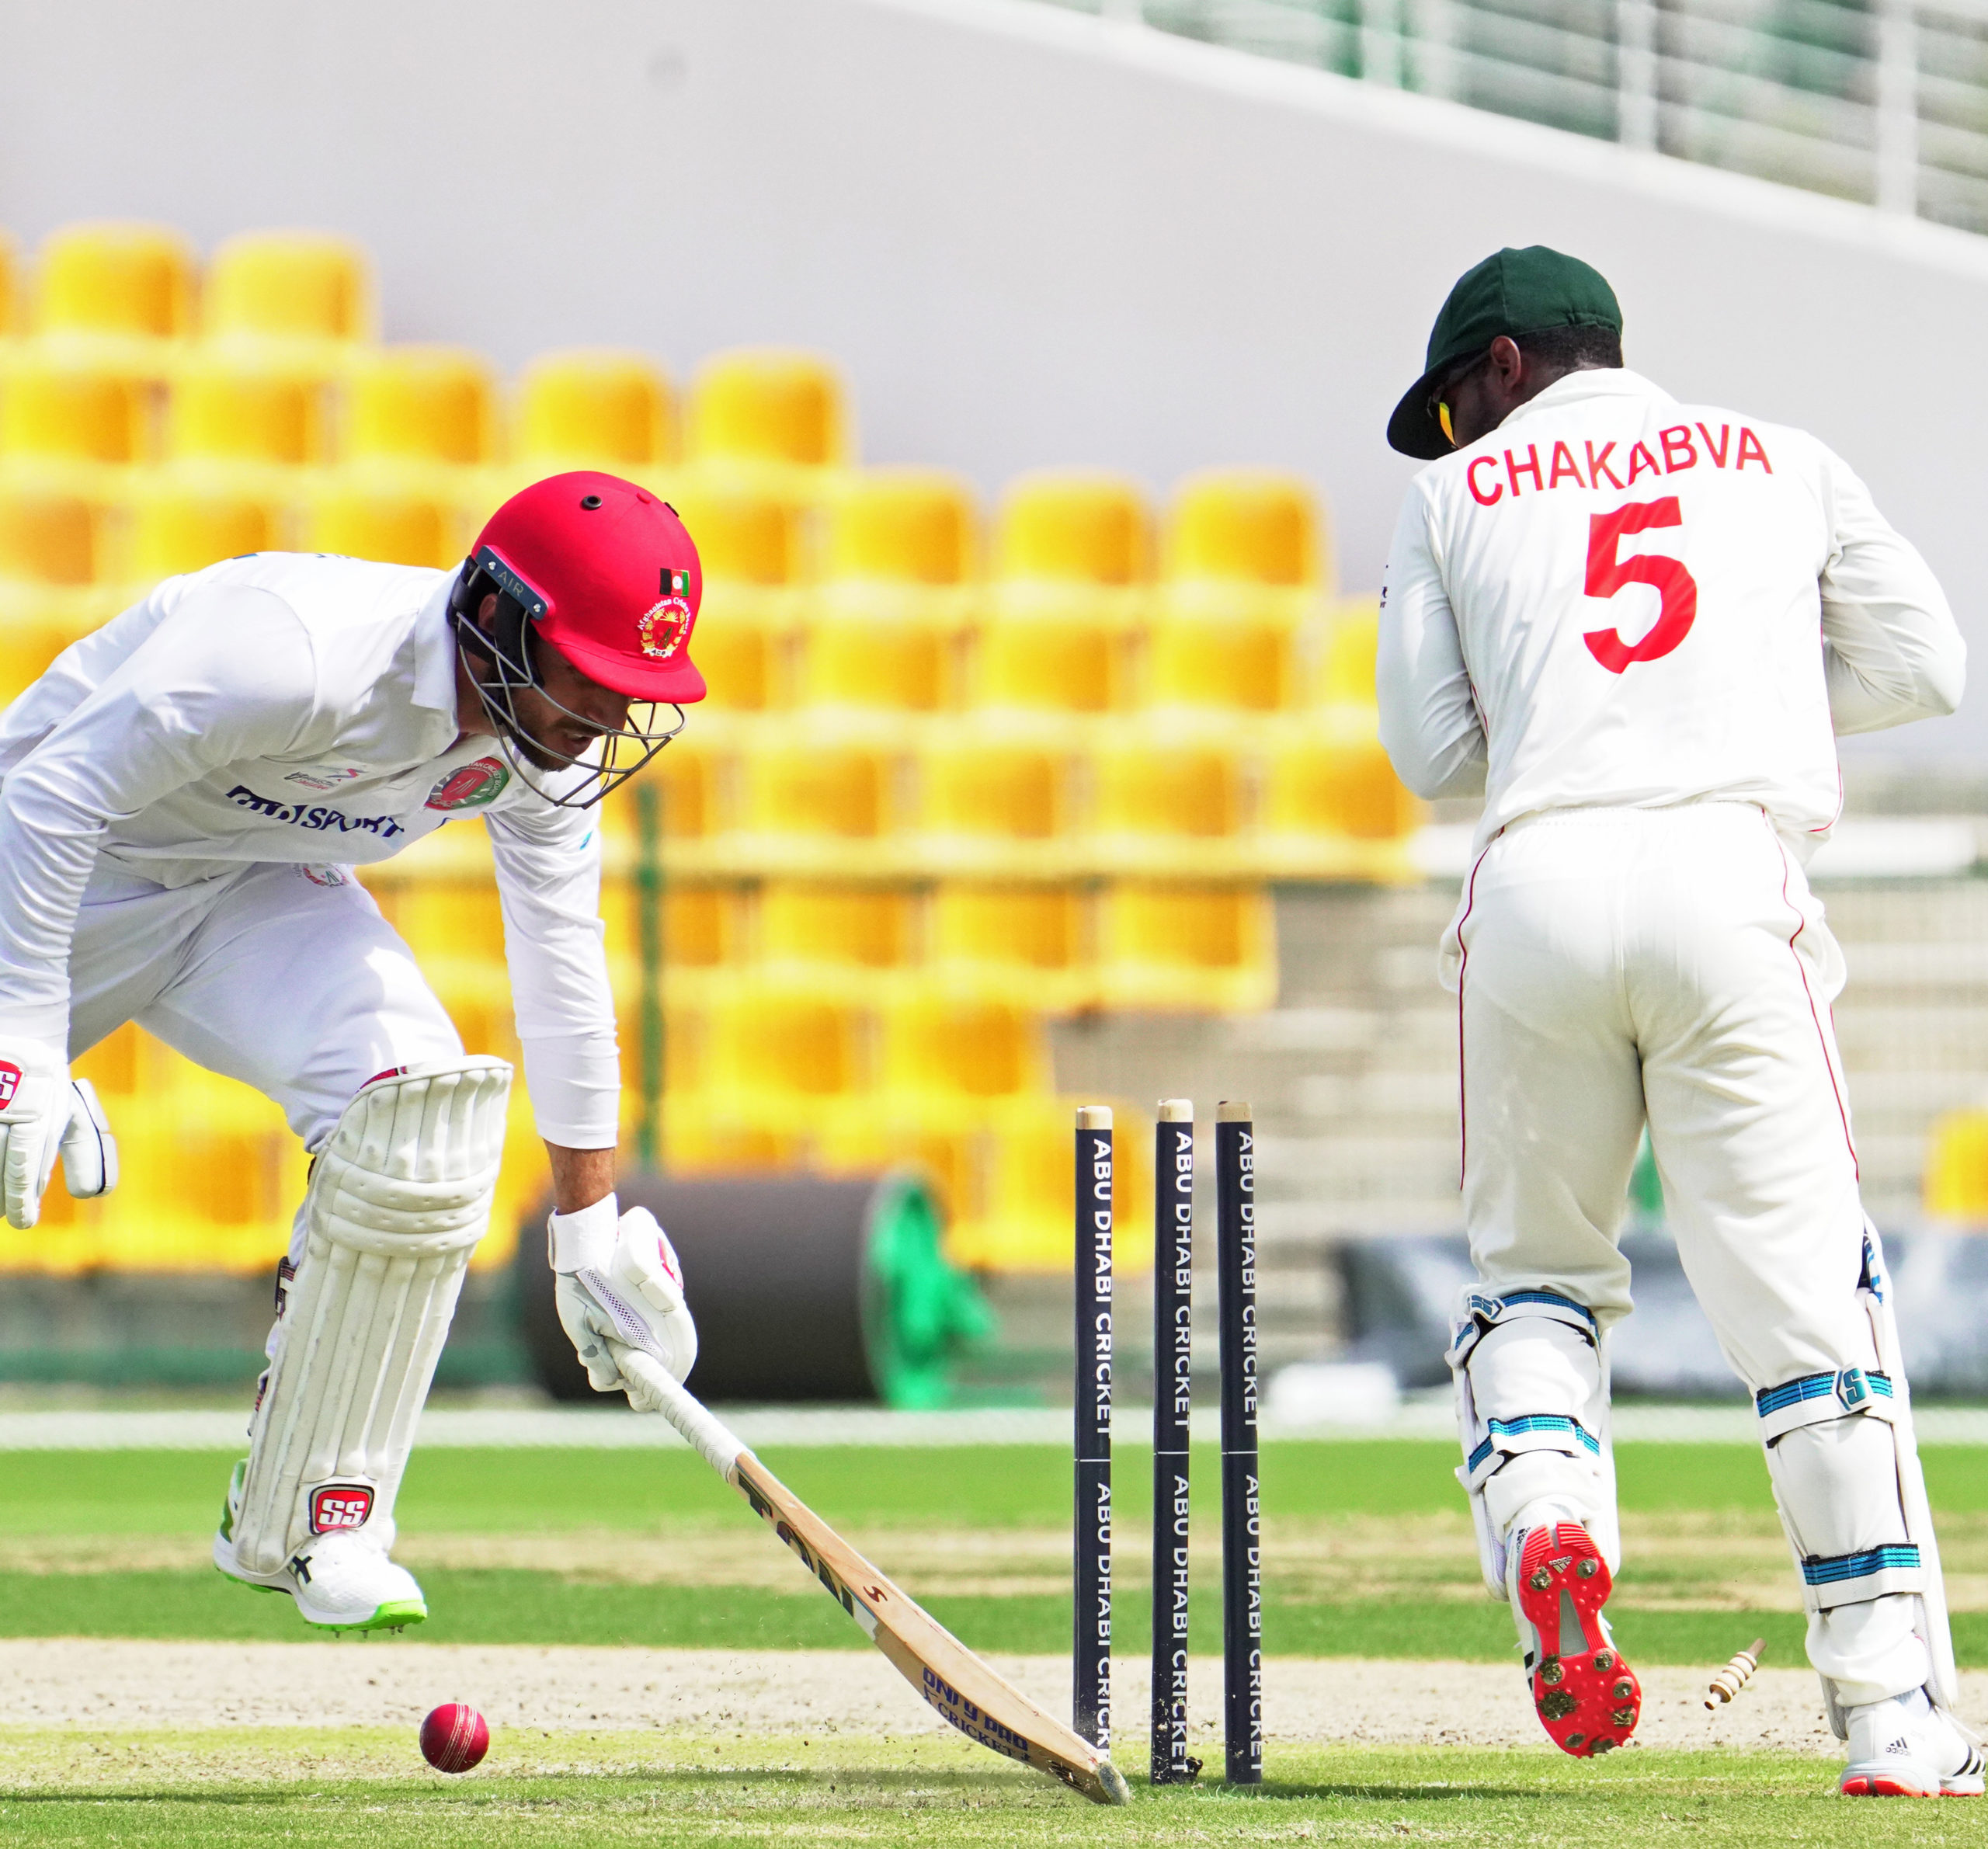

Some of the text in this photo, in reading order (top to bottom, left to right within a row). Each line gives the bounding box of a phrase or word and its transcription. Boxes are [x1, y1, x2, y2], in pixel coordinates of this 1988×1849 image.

[1467, 422, 1774, 506] CHAKABVA
[498, 571, 524, 597] AIR
[1583, 495, 1697, 675] 5
[1093, 1138, 1112, 1439] ABU DHABI CRICKET
[1174, 1131, 1192, 1431] ABU DHABI CRICKET
[1239, 1131, 1257, 1427] ABU DHABI CRICKET
[318, 1498, 365, 1525] SS
[1097, 1482, 1110, 1544] ABU
[1097, 1555, 1110, 1646] DHABI
[1171, 1475, 1189, 1771] ABU DHABI CRICKET
[1246, 1475, 1263, 1771] ABU DHABI CRICKET
